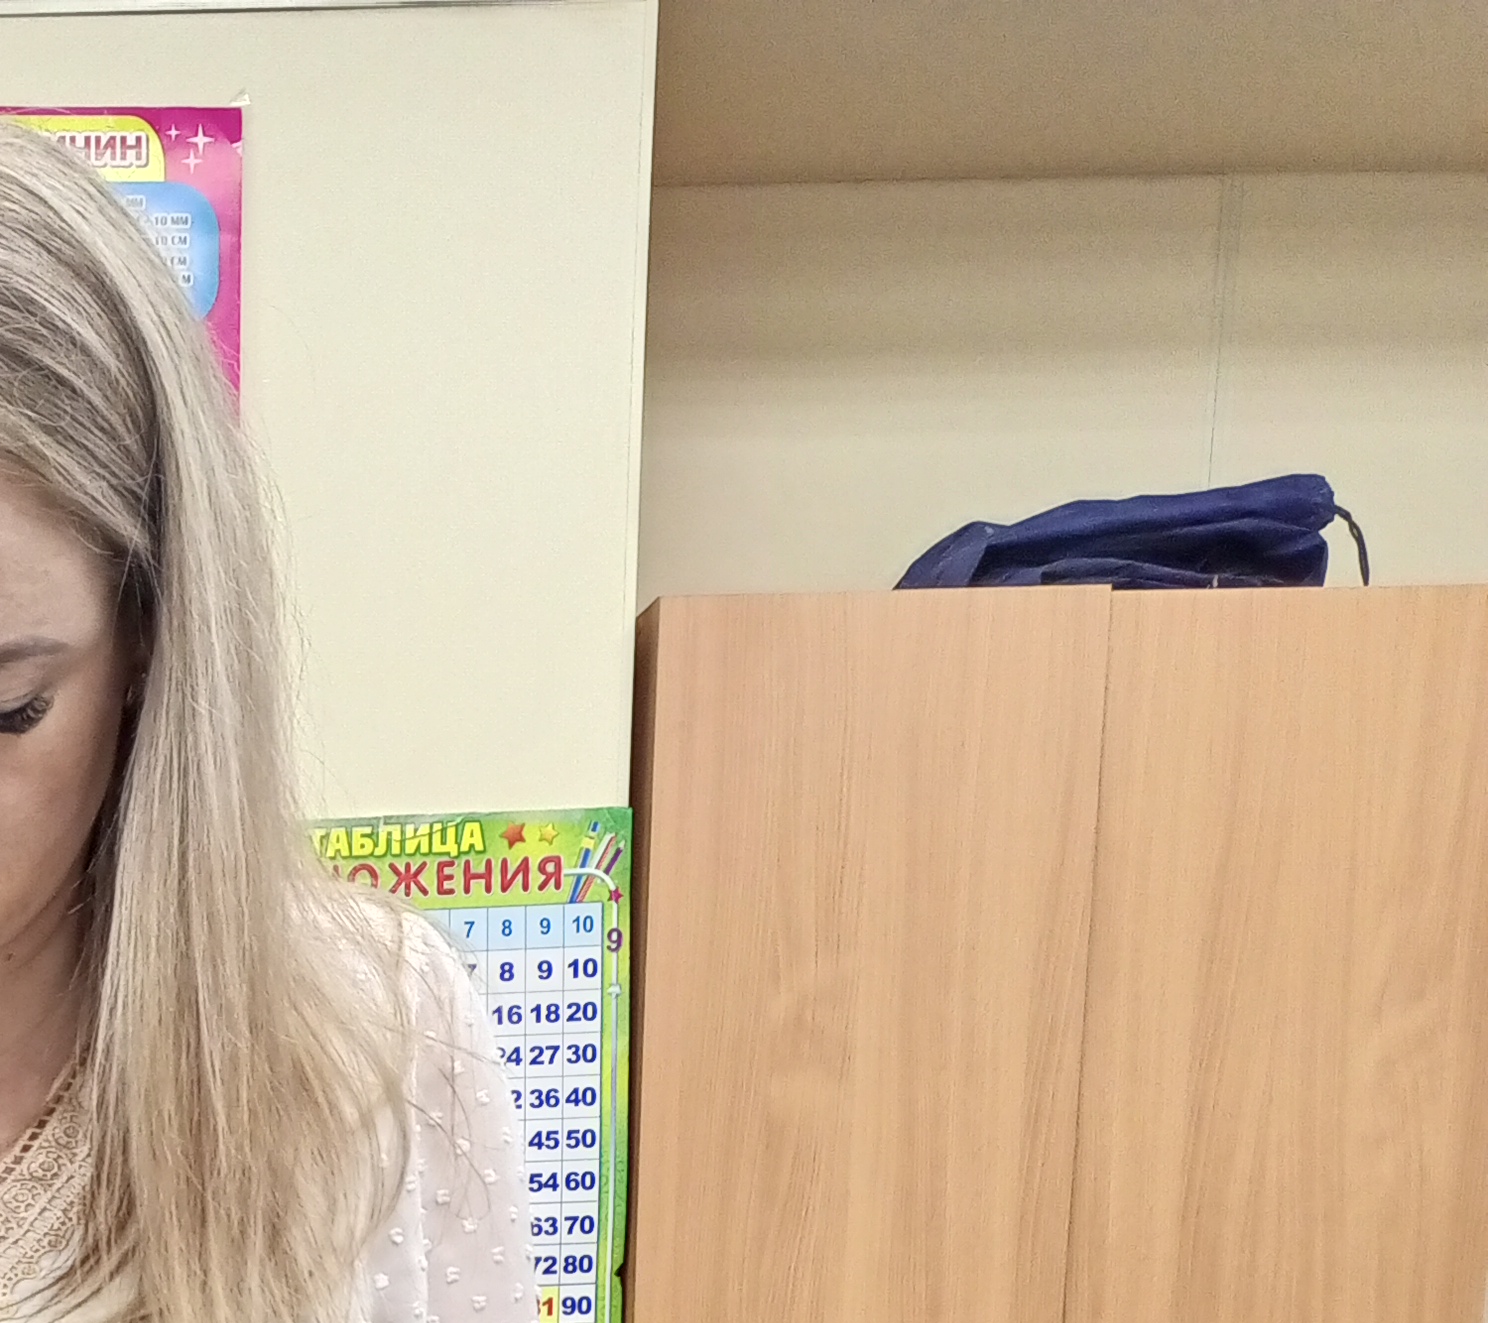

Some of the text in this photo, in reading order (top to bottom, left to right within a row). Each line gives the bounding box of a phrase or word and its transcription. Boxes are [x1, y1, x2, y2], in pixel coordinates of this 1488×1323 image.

[56, 133, 144, 163] ЧИН
[154, 215, 189, 226] 10 ММ
[311, 820, 486, 858] ТАБЛИЦА
[332, 854, 563, 898] ОЖЕНИЯ
[464, 915, 594, 938] 7 8 9 10
[606, 927, 624, 953] 9
[499, 961, 515, 982] 8
[537, 959, 553, 980] 9
[567, 957, 598, 979] 10
[492, 1001, 598, 1026] 16 18 20
[529, 1045, 561, 1066] 27
[566, 1043, 597, 1064] 30
[529, 1088, 560, 1109] 36
[565, 1086, 597, 1107] 40
[528, 1128, 597, 1150] 45 50
[528, 1170, 596, 1193] 54 60
[530, 1215, 595, 1236] 63 70
[534, 1254, 594, 1275] 72 80
[561, 1295, 592, 1316] 90
